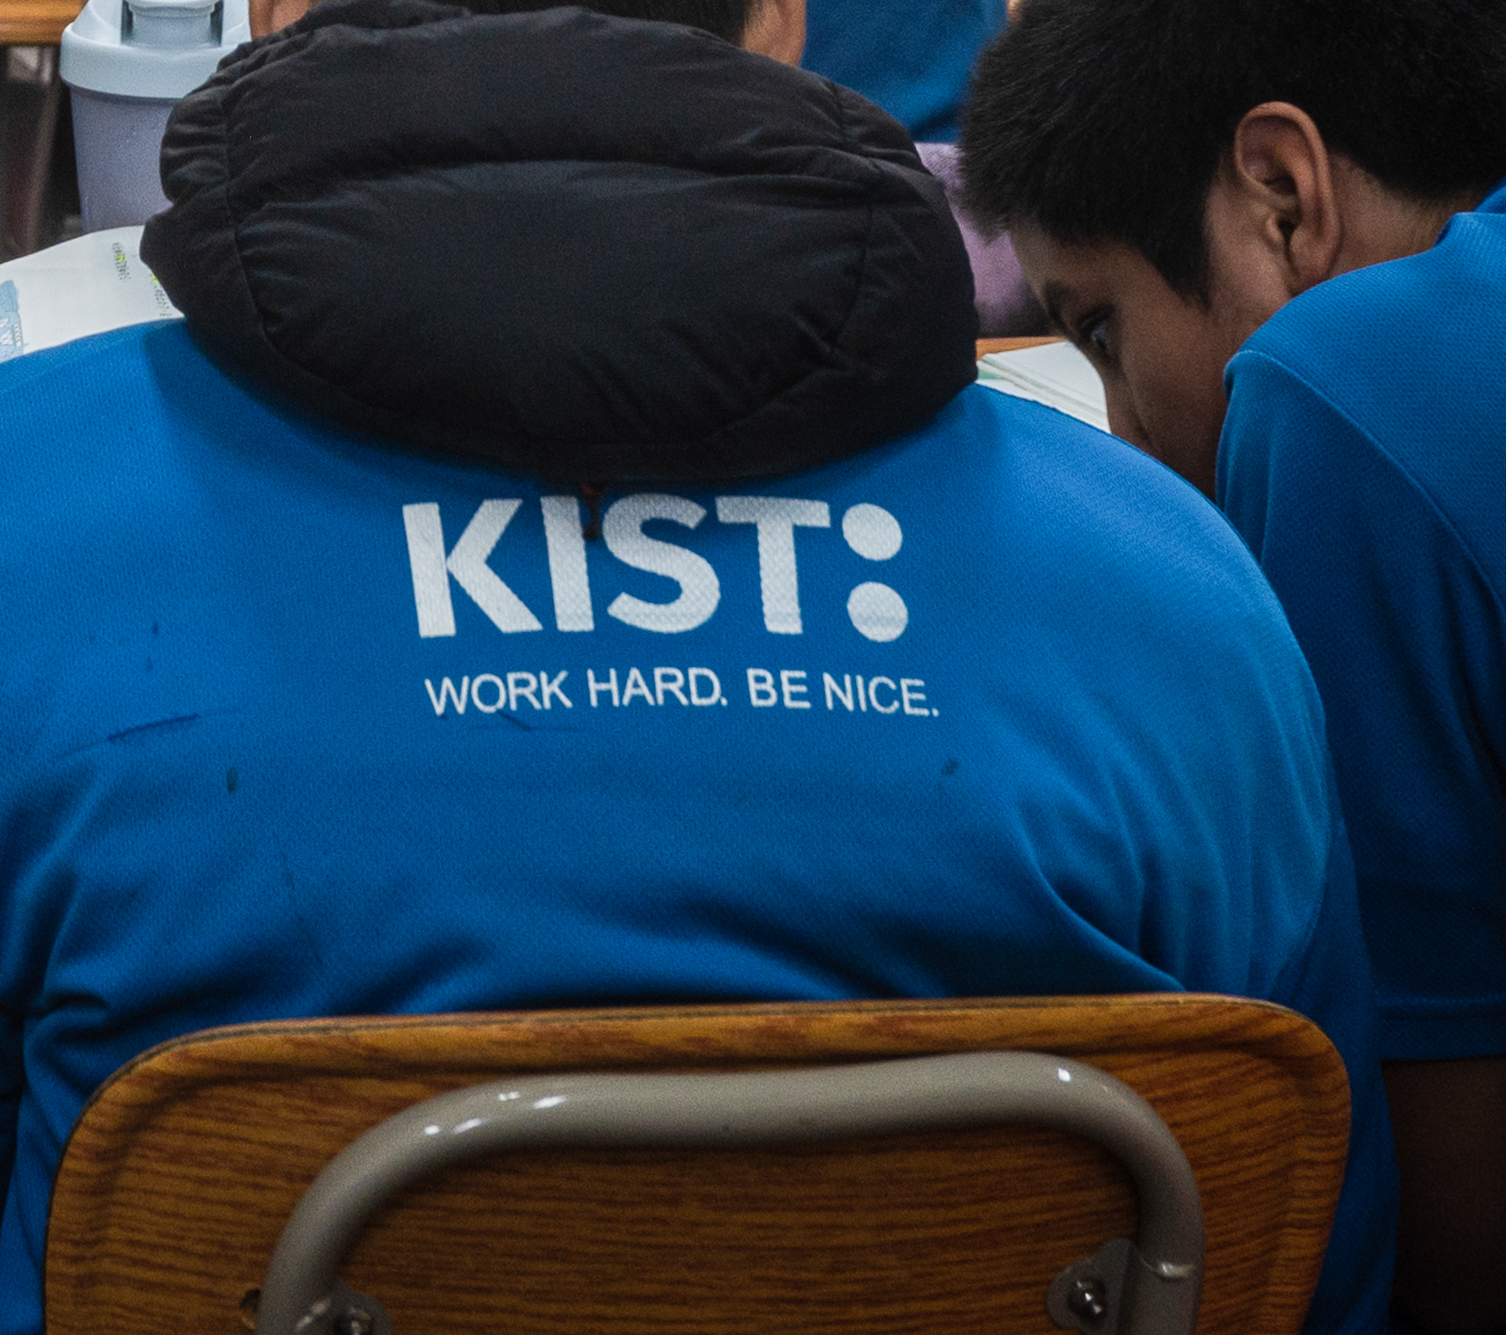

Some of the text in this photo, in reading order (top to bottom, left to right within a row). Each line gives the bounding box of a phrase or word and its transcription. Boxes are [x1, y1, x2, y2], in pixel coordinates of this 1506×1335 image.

[424, 666, 940, 718] WORK HARD. BE NICE.
